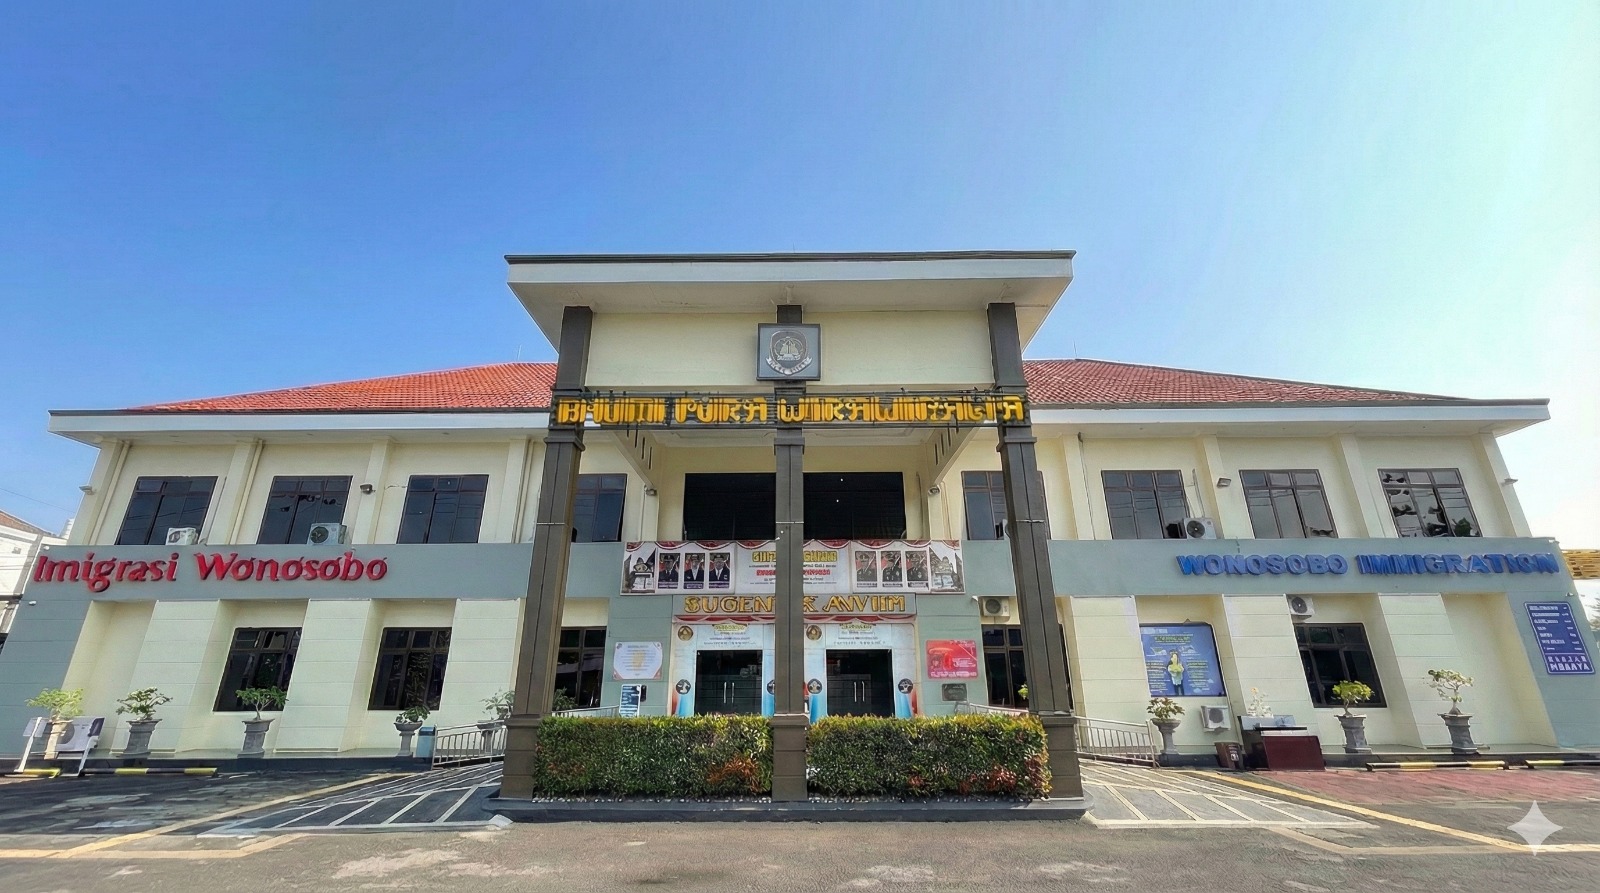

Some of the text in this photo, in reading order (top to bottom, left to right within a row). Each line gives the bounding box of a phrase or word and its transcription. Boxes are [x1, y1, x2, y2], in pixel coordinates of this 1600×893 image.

[33, 549, 388, 593] Imigrasi Wonosobo
[1175, 552, 1560, 576] WONOSOBO IMMIGRATION
